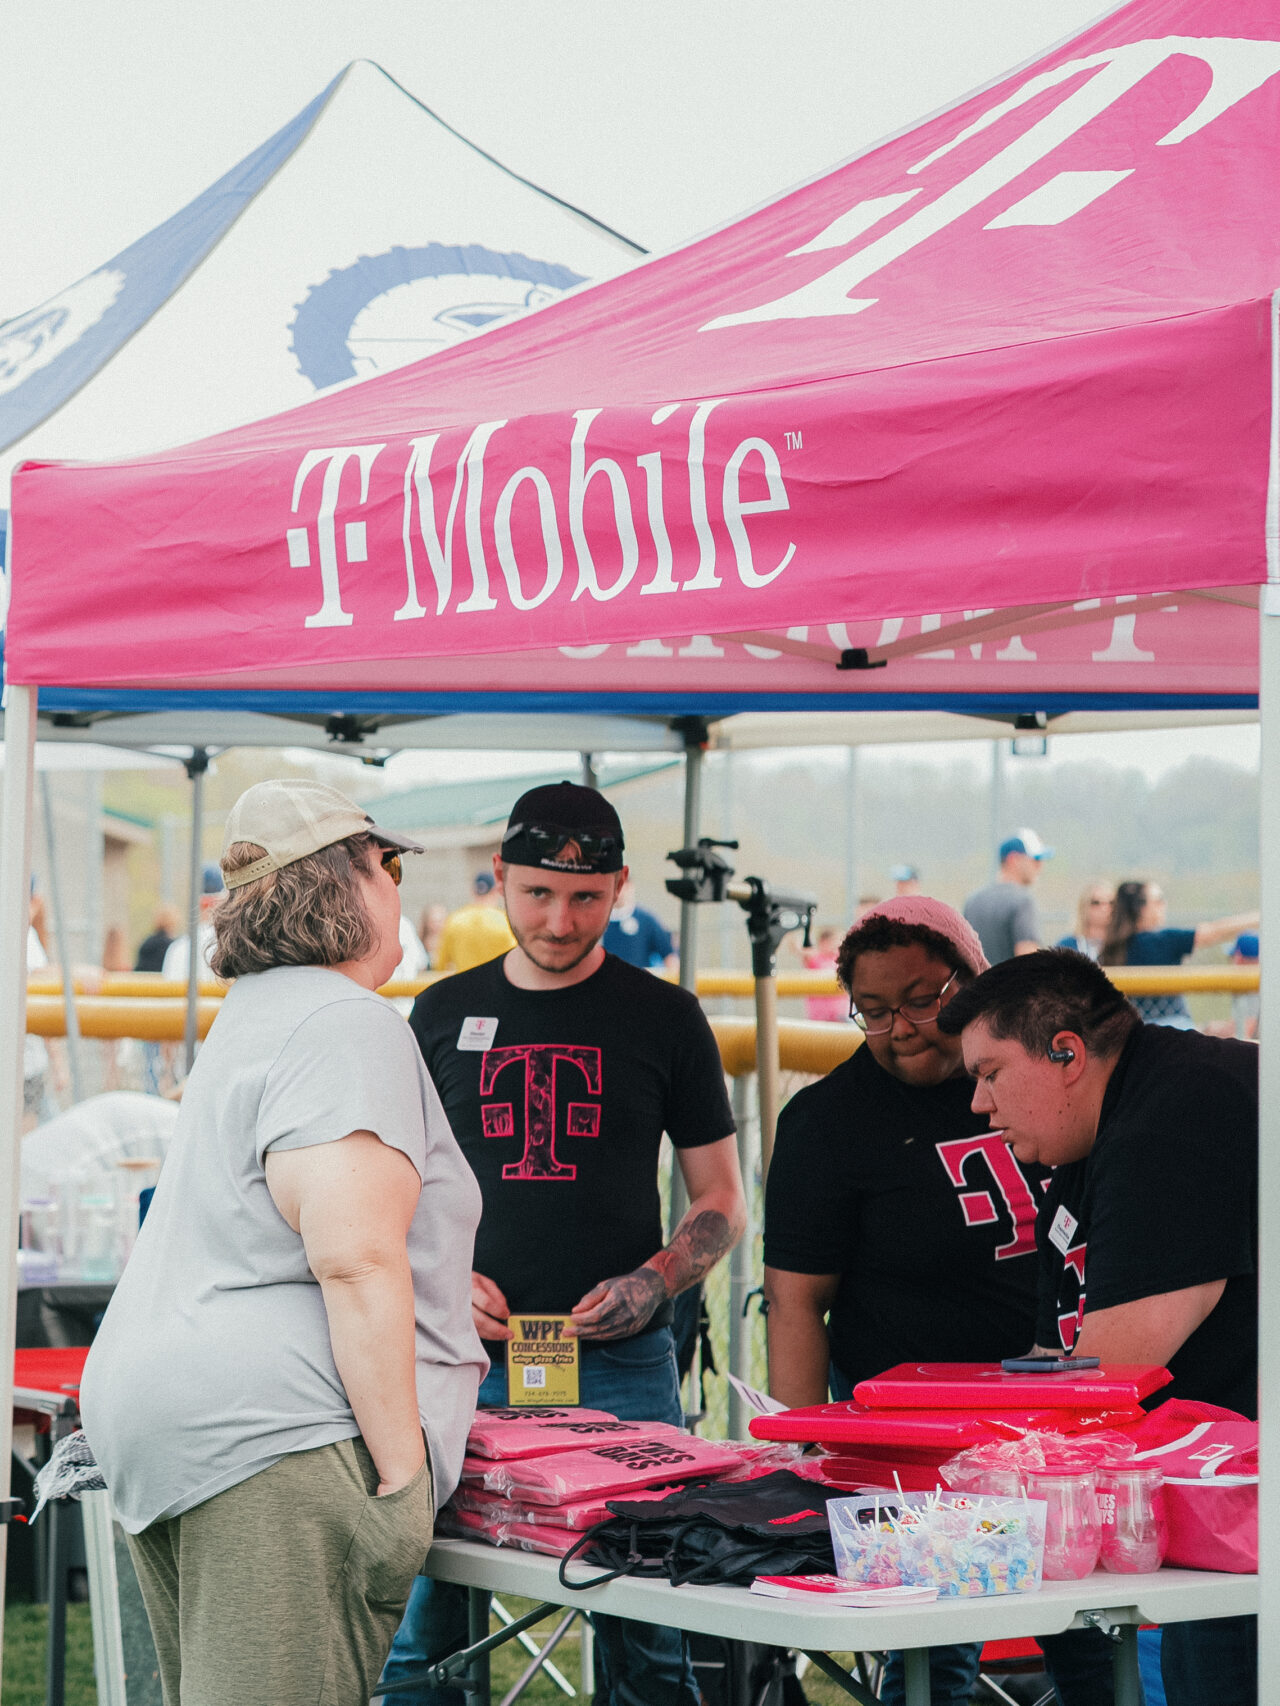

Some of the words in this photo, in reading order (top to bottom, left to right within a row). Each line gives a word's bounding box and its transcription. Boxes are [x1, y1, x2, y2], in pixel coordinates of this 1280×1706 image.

[392, 398, 797, 622] Mobile
[520, 1320, 565, 1340] WPF
[511, 1342, 574, 1353] CONCESSIONS
